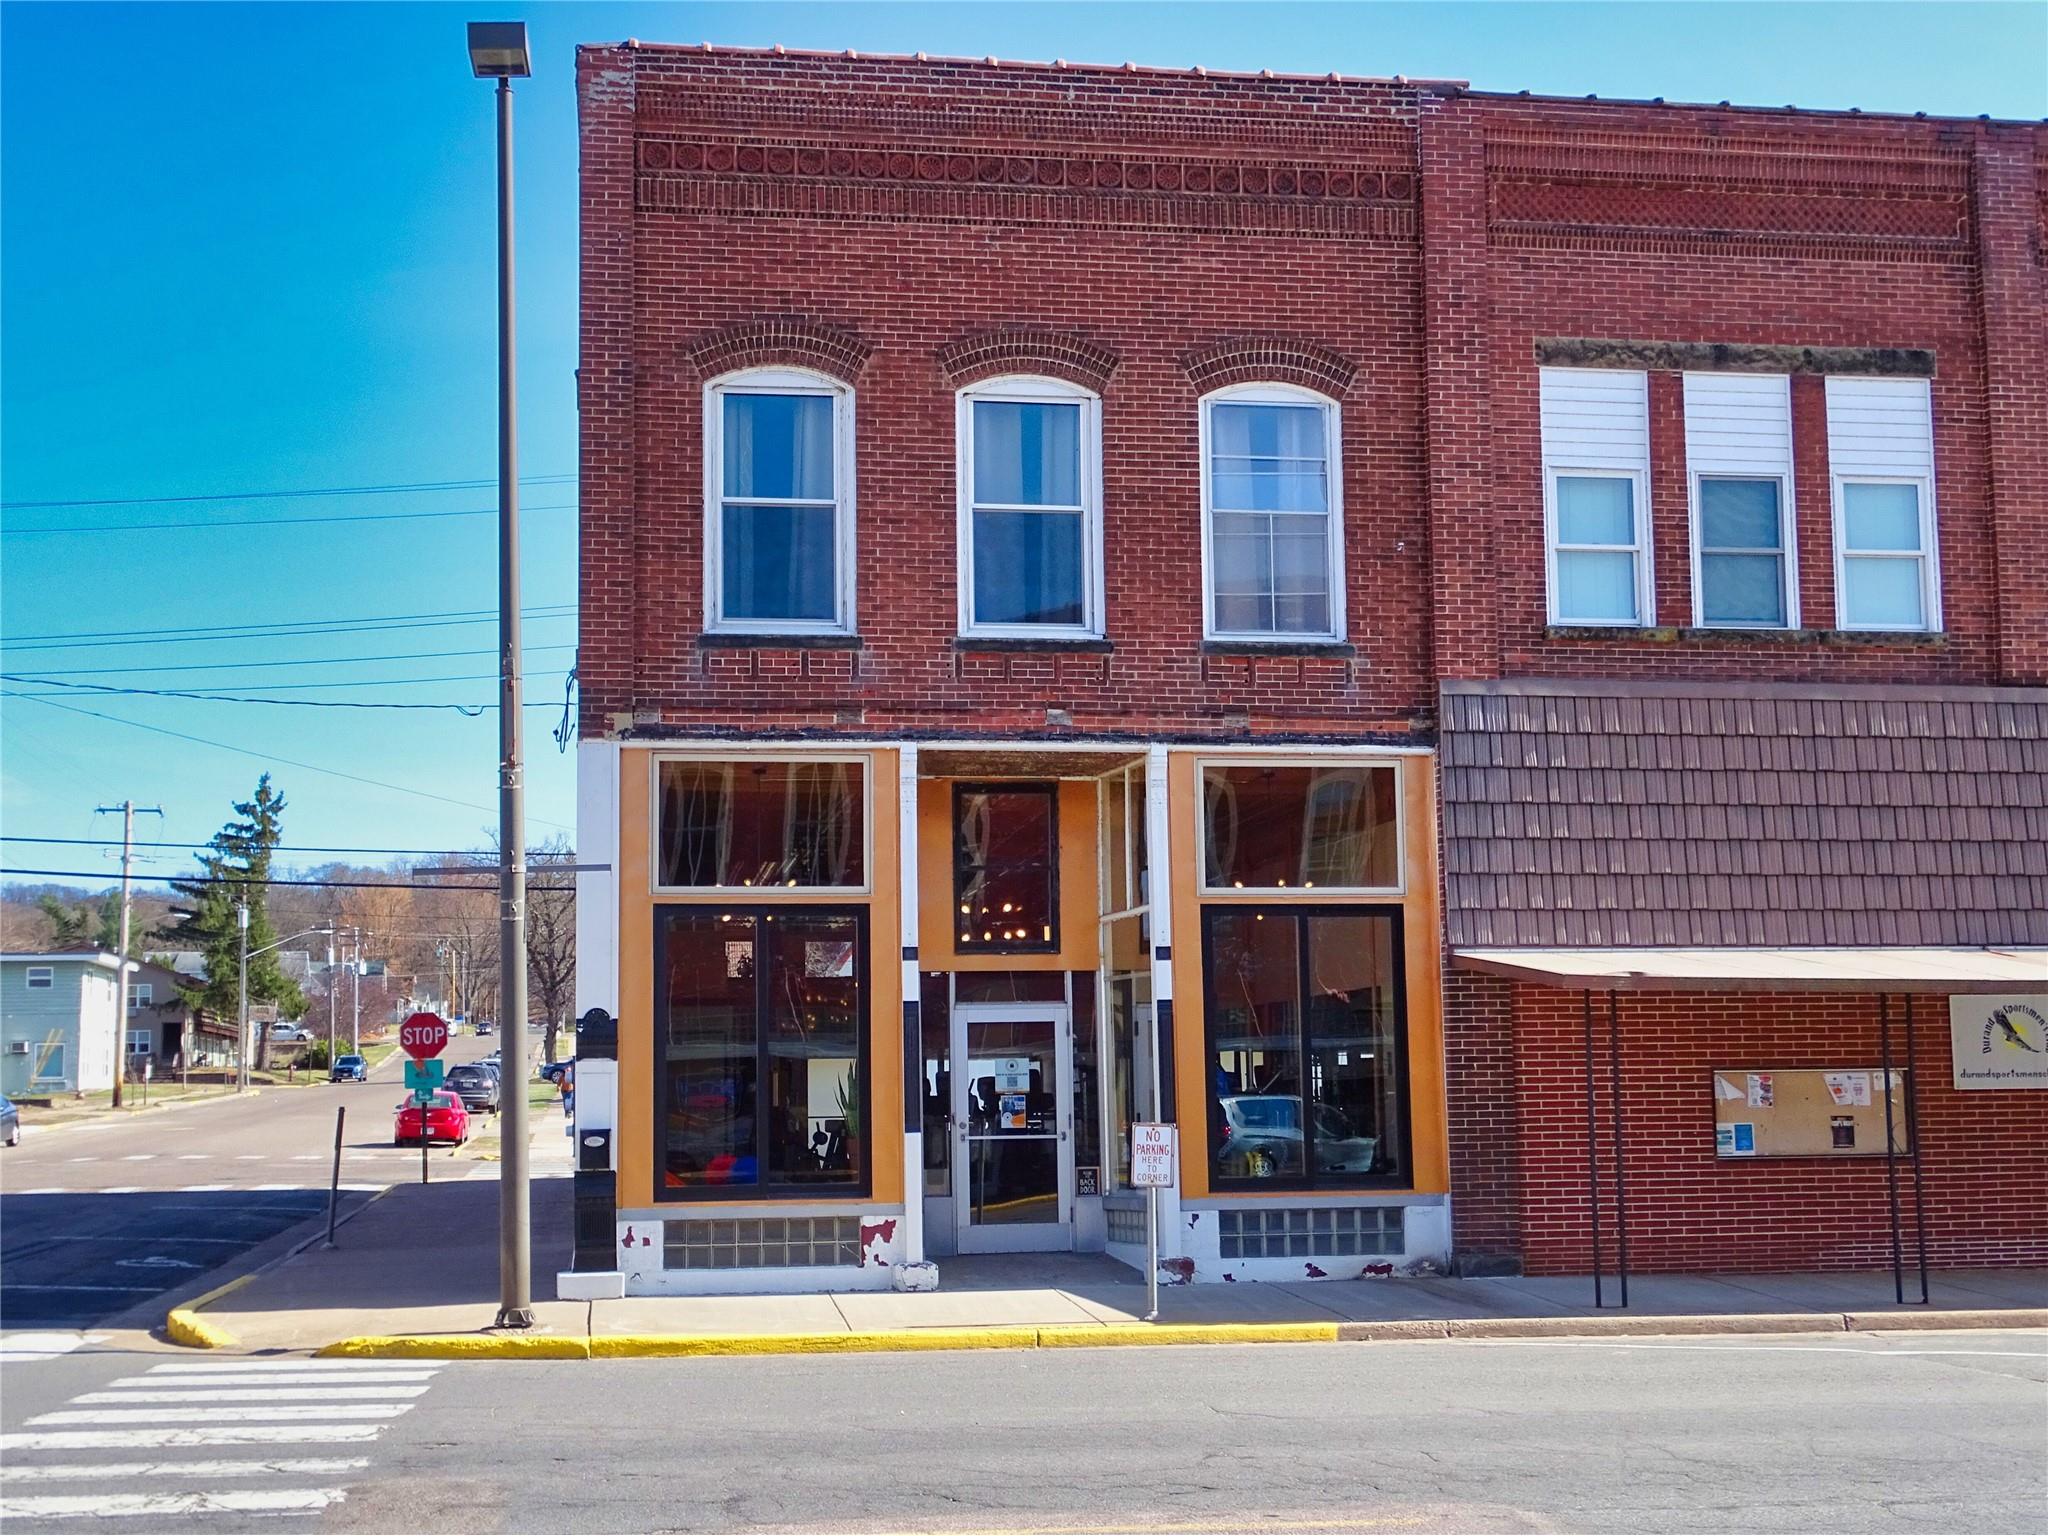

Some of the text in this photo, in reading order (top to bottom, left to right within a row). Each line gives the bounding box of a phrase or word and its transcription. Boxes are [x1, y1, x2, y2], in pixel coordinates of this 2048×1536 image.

[403, 1026, 445, 1045] STOP
[1982, 1017, 1996, 1054] Durand
[1145, 1130, 1161, 1142] NO
[1136, 1143, 1170, 1156] PARKING
[1141, 1156, 1163, 1165] HERE
[1147, 1165, 1157, 1173] TO
[1136, 1173, 1169, 1182] CORNER
[1079, 1186, 1097, 1194] DOOR
